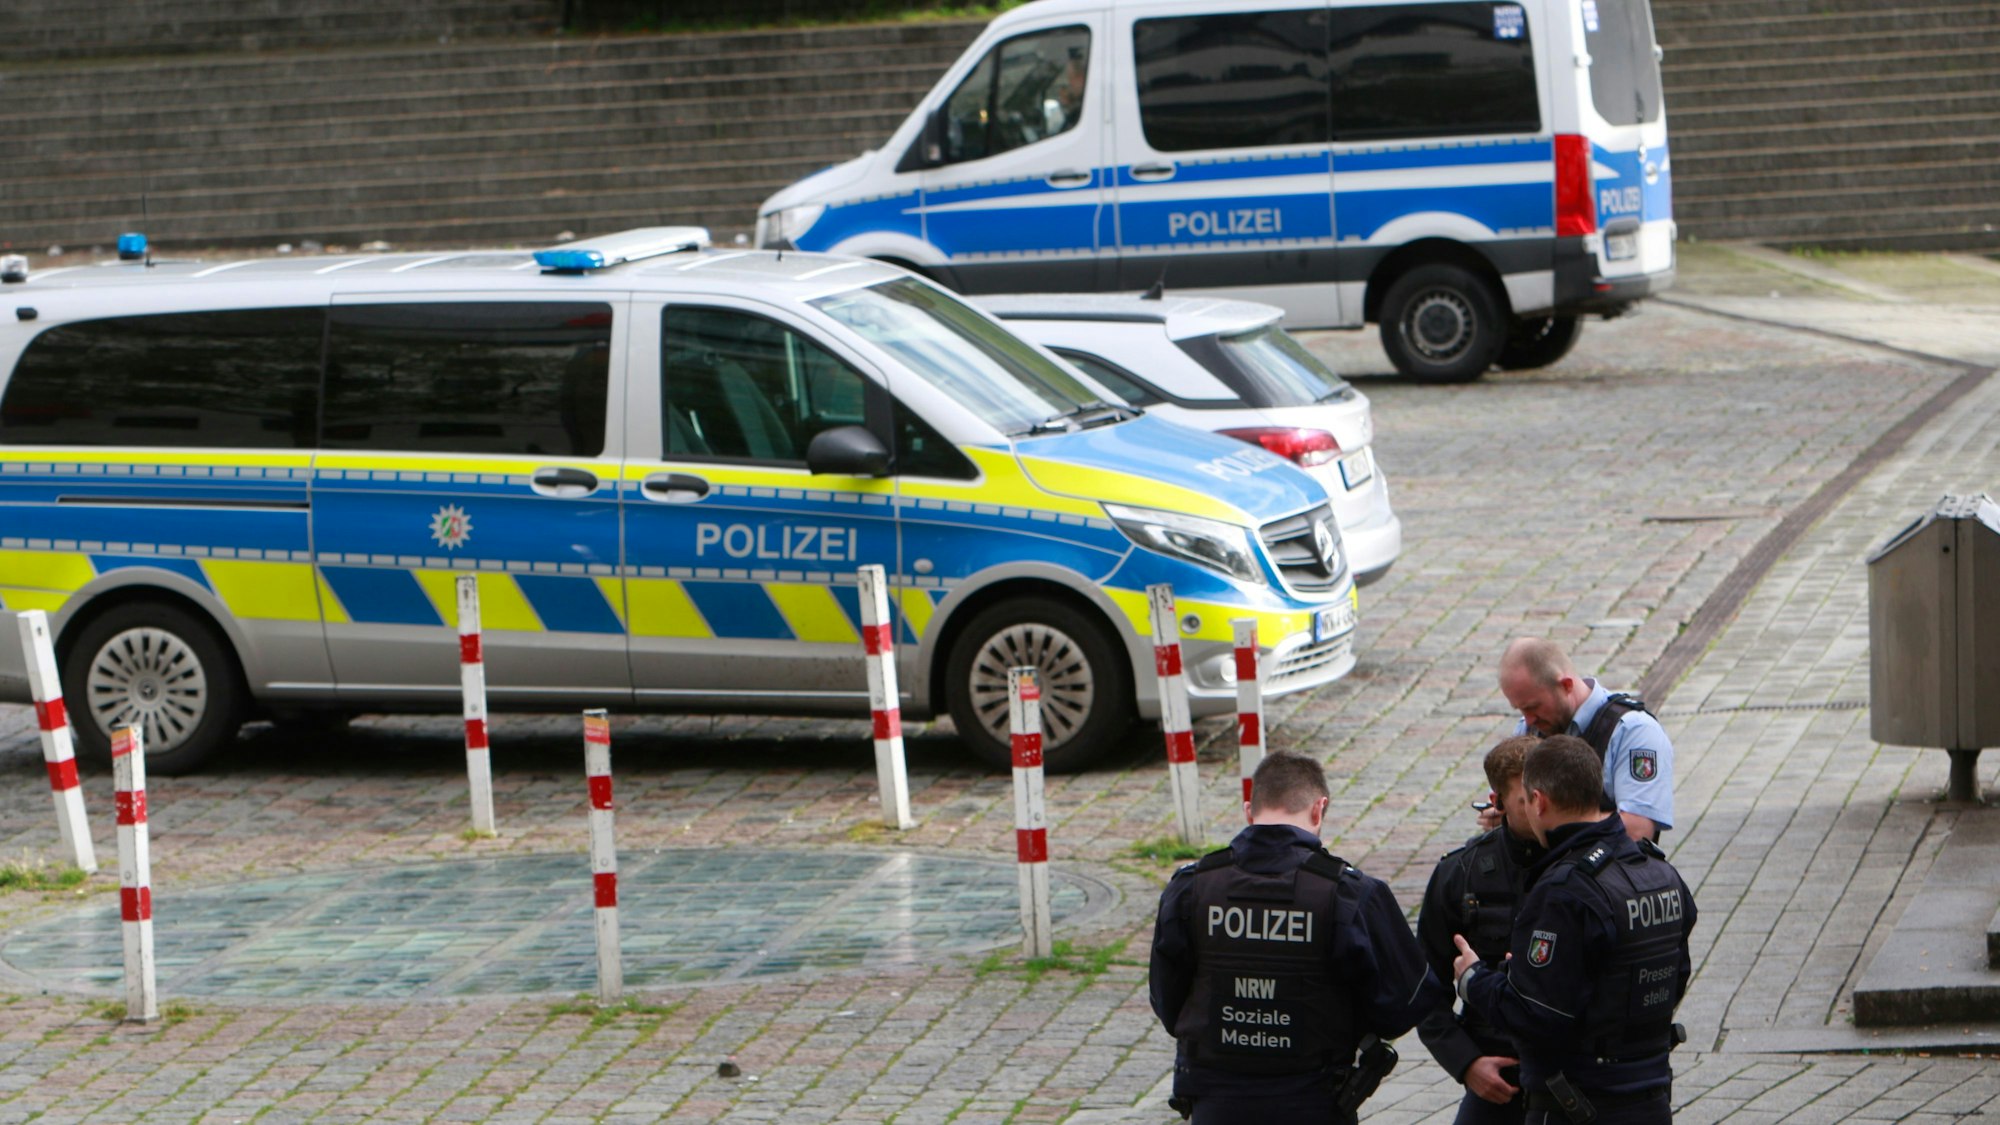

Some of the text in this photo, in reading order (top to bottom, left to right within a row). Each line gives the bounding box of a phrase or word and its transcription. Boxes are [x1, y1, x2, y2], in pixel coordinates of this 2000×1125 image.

[1168, 208, 1281, 238] POLIZEI
[696, 523, 858, 561] POLIZEI
[1626, 889, 1682, 930] POLIZEI
[1208, 905, 1313, 942] POLIZEI
[1638, 965, 1676, 984] Presse-
[1234, 977, 1276, 1000] NRW
[1643, 988, 1670, 1007] stelle
[1222, 1006, 1291, 1025] Soziale
[1221, 1028, 1291, 1048] Medien
